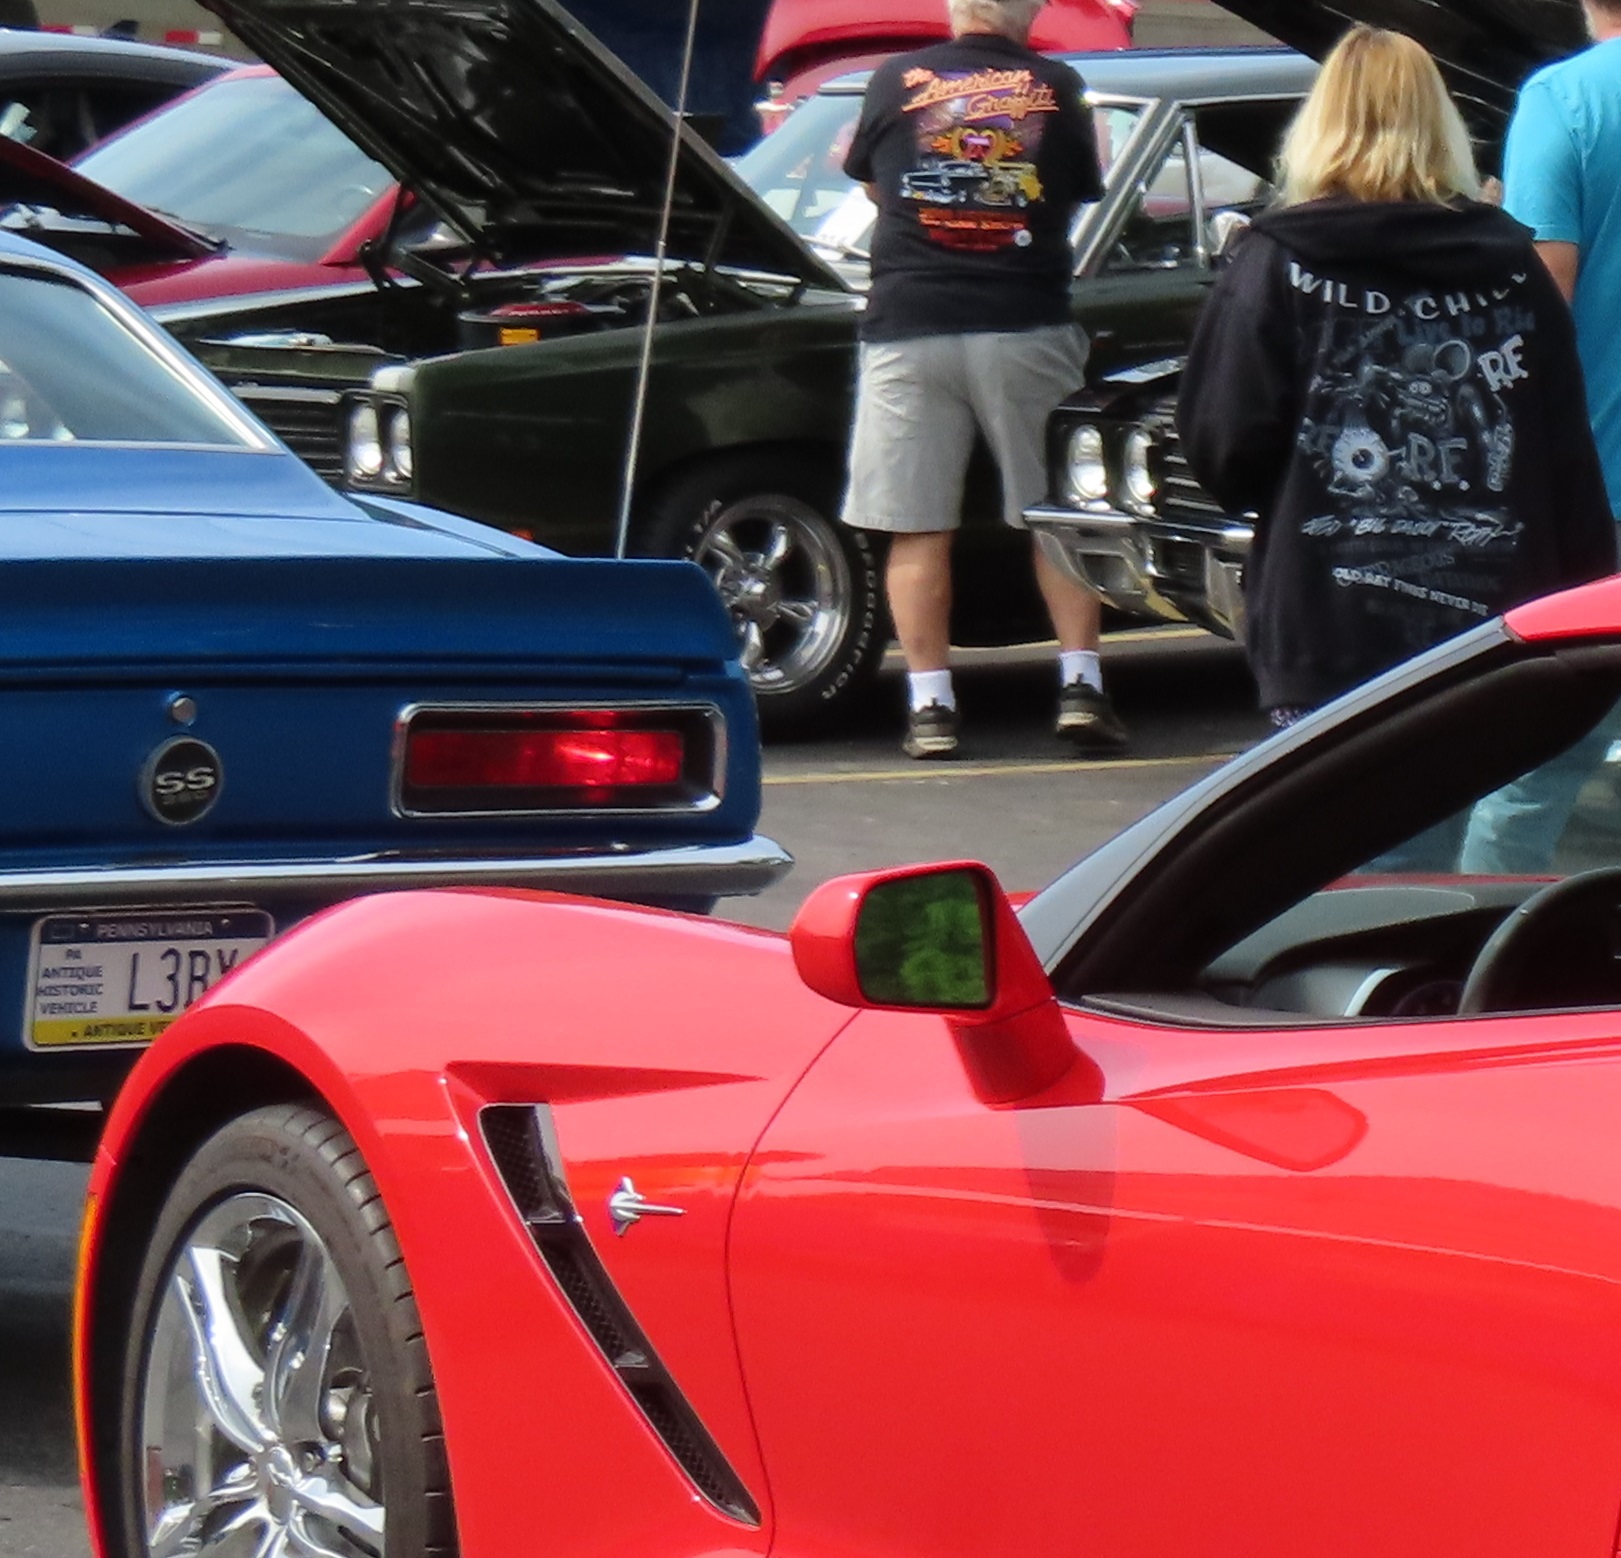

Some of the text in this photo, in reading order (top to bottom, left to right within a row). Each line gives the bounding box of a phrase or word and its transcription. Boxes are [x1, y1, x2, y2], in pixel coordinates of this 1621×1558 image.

[904, 68, 1034, 111] American
[1289, 261, 1392, 315] WILD
[155, 766, 216, 795] SS
[97, 920, 214, 939] PENNSYLVANIA
[42, 965, 104, 981] ANTIQUE
[37, 983, 104, 998] HISTORIC
[40, 1001, 98, 1015] VEHICLE
